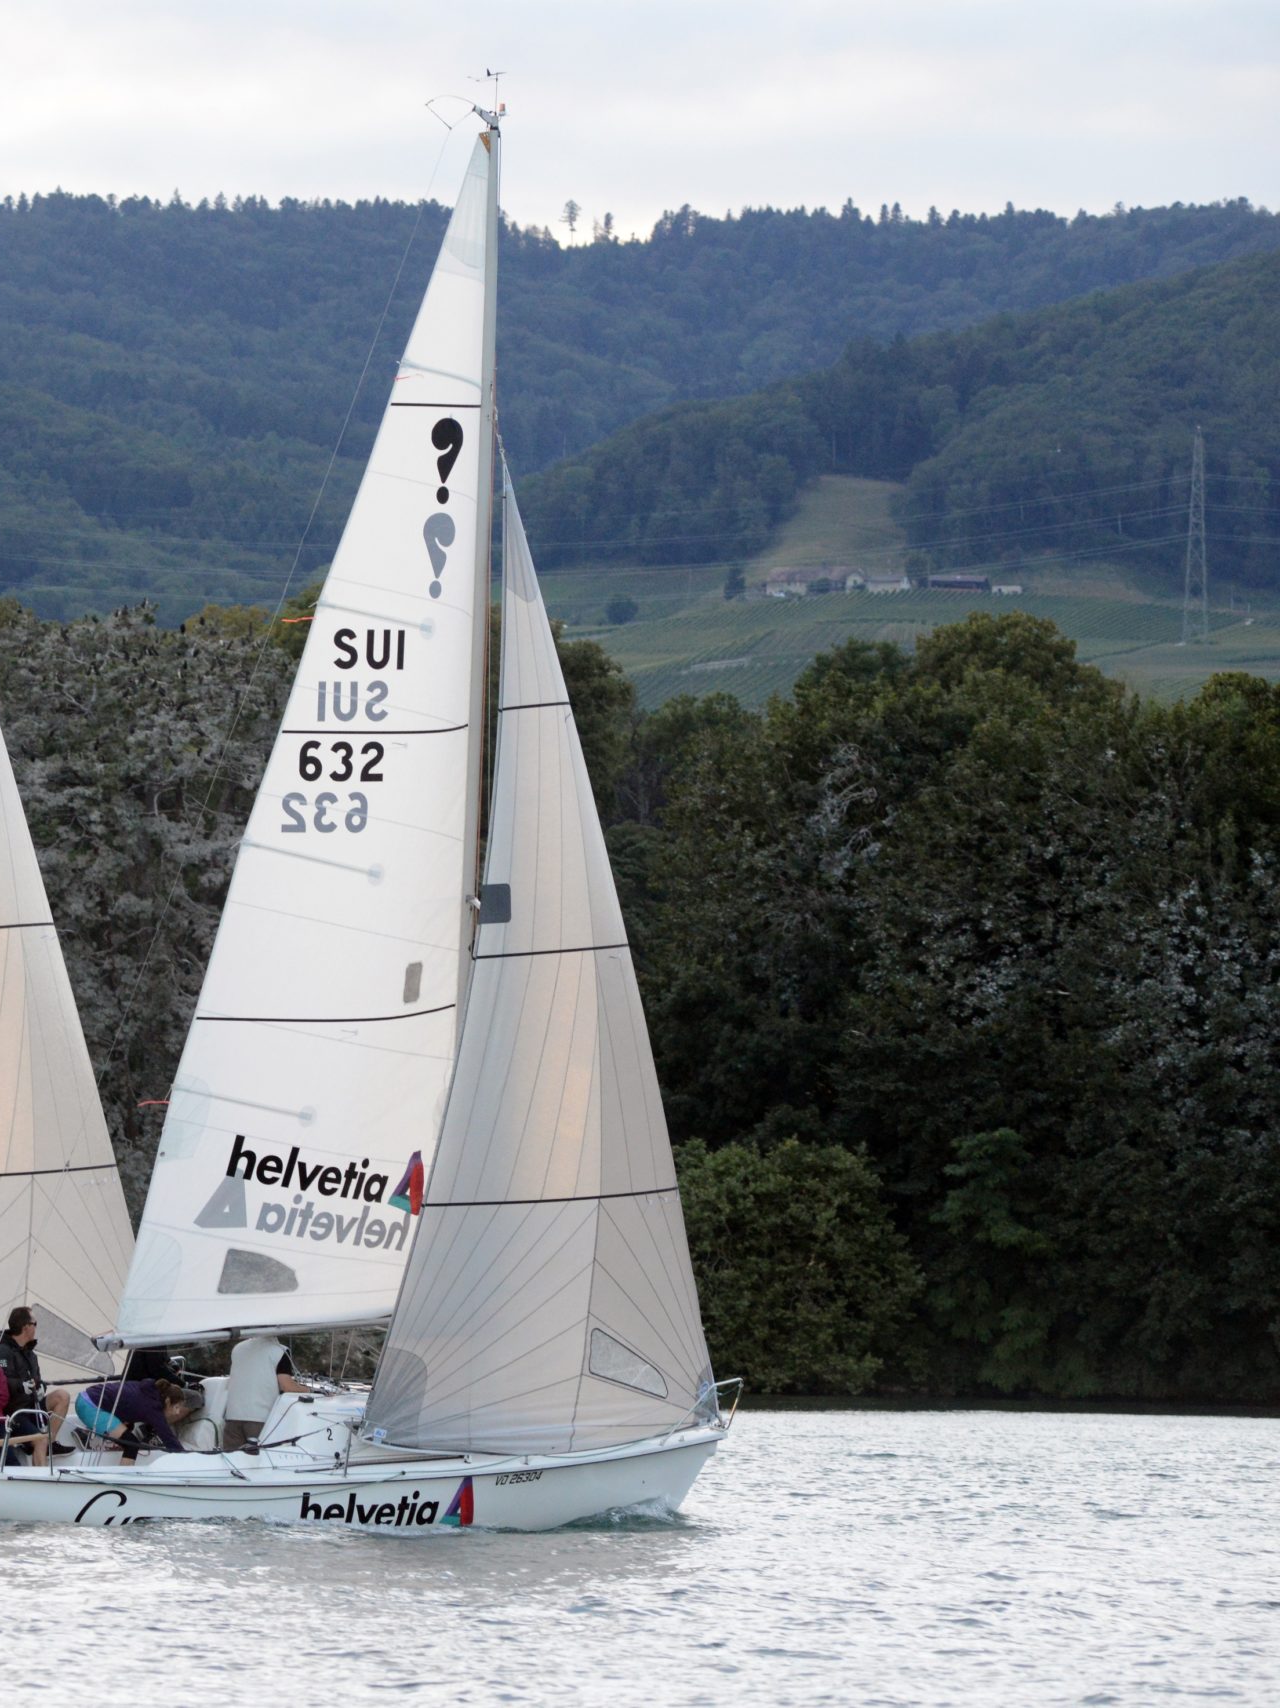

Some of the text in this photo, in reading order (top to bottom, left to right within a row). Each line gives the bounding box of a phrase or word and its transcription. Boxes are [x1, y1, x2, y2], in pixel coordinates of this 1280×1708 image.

[332, 628, 405, 670] SUI
[298, 740, 385, 782] 632
[226, 1134, 389, 1204] helvetia
[326, 1428, 333, 1441] 2
[509, 1470, 544, 1485] 26304
[300, 1490, 440, 1527] helvetia
